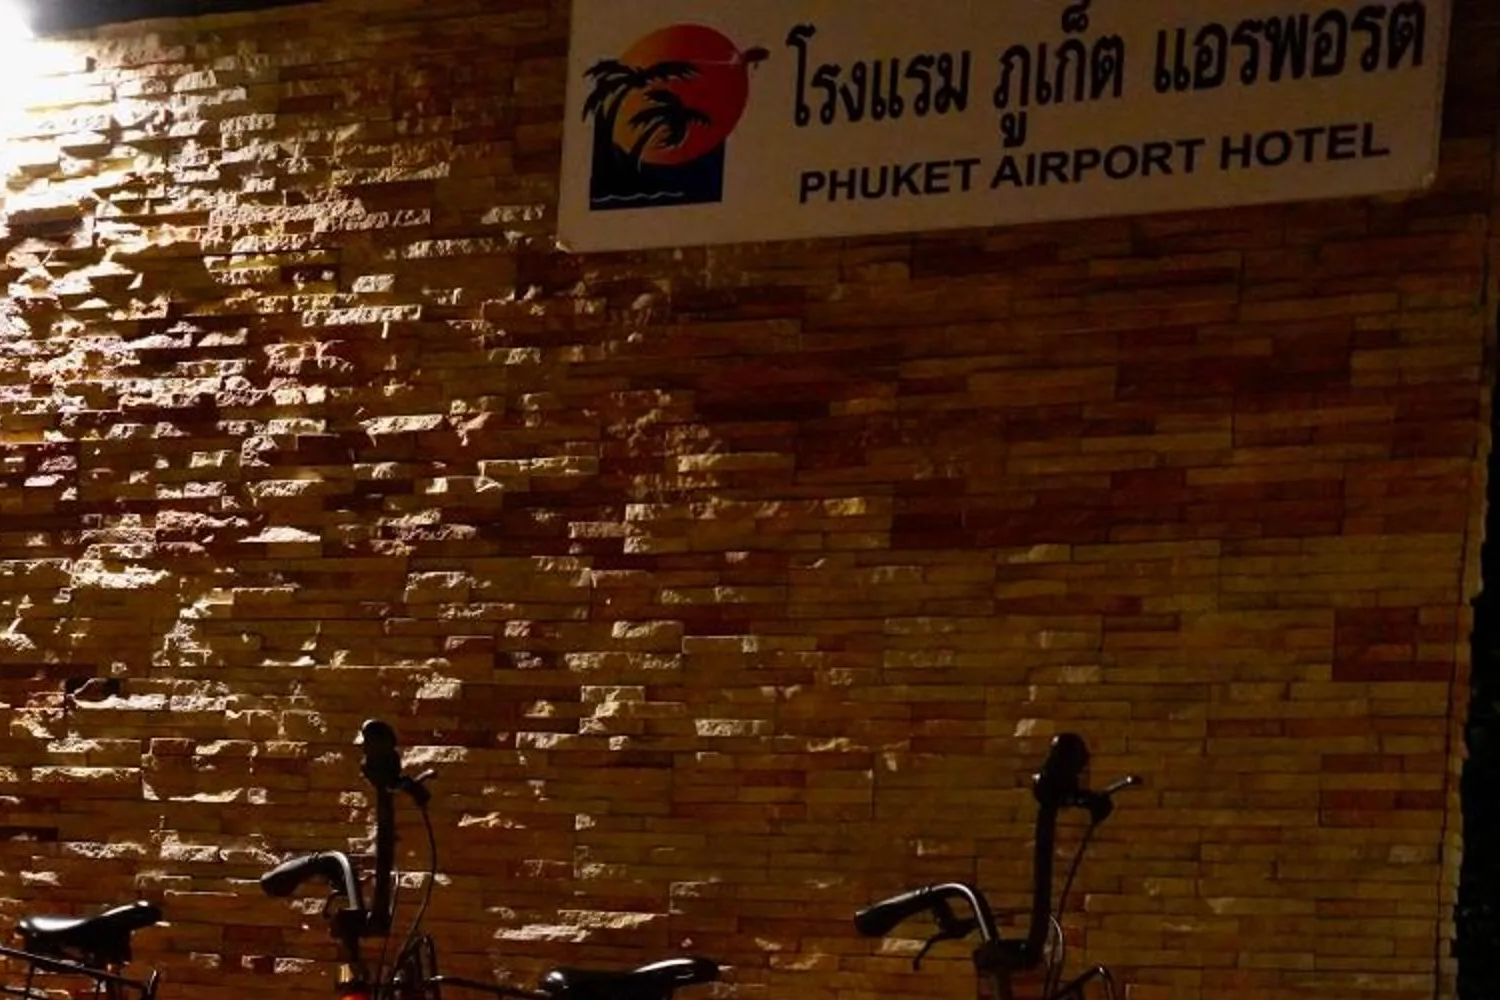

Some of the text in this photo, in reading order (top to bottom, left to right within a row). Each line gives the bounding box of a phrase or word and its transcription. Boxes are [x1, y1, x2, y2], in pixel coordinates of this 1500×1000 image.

[786, 24, 971, 127] โรงแรม
[994, 0, 1125, 148] ภูเก็ต
[800, 122, 1390, 204] PHUKET AIRPORT HOTEL
